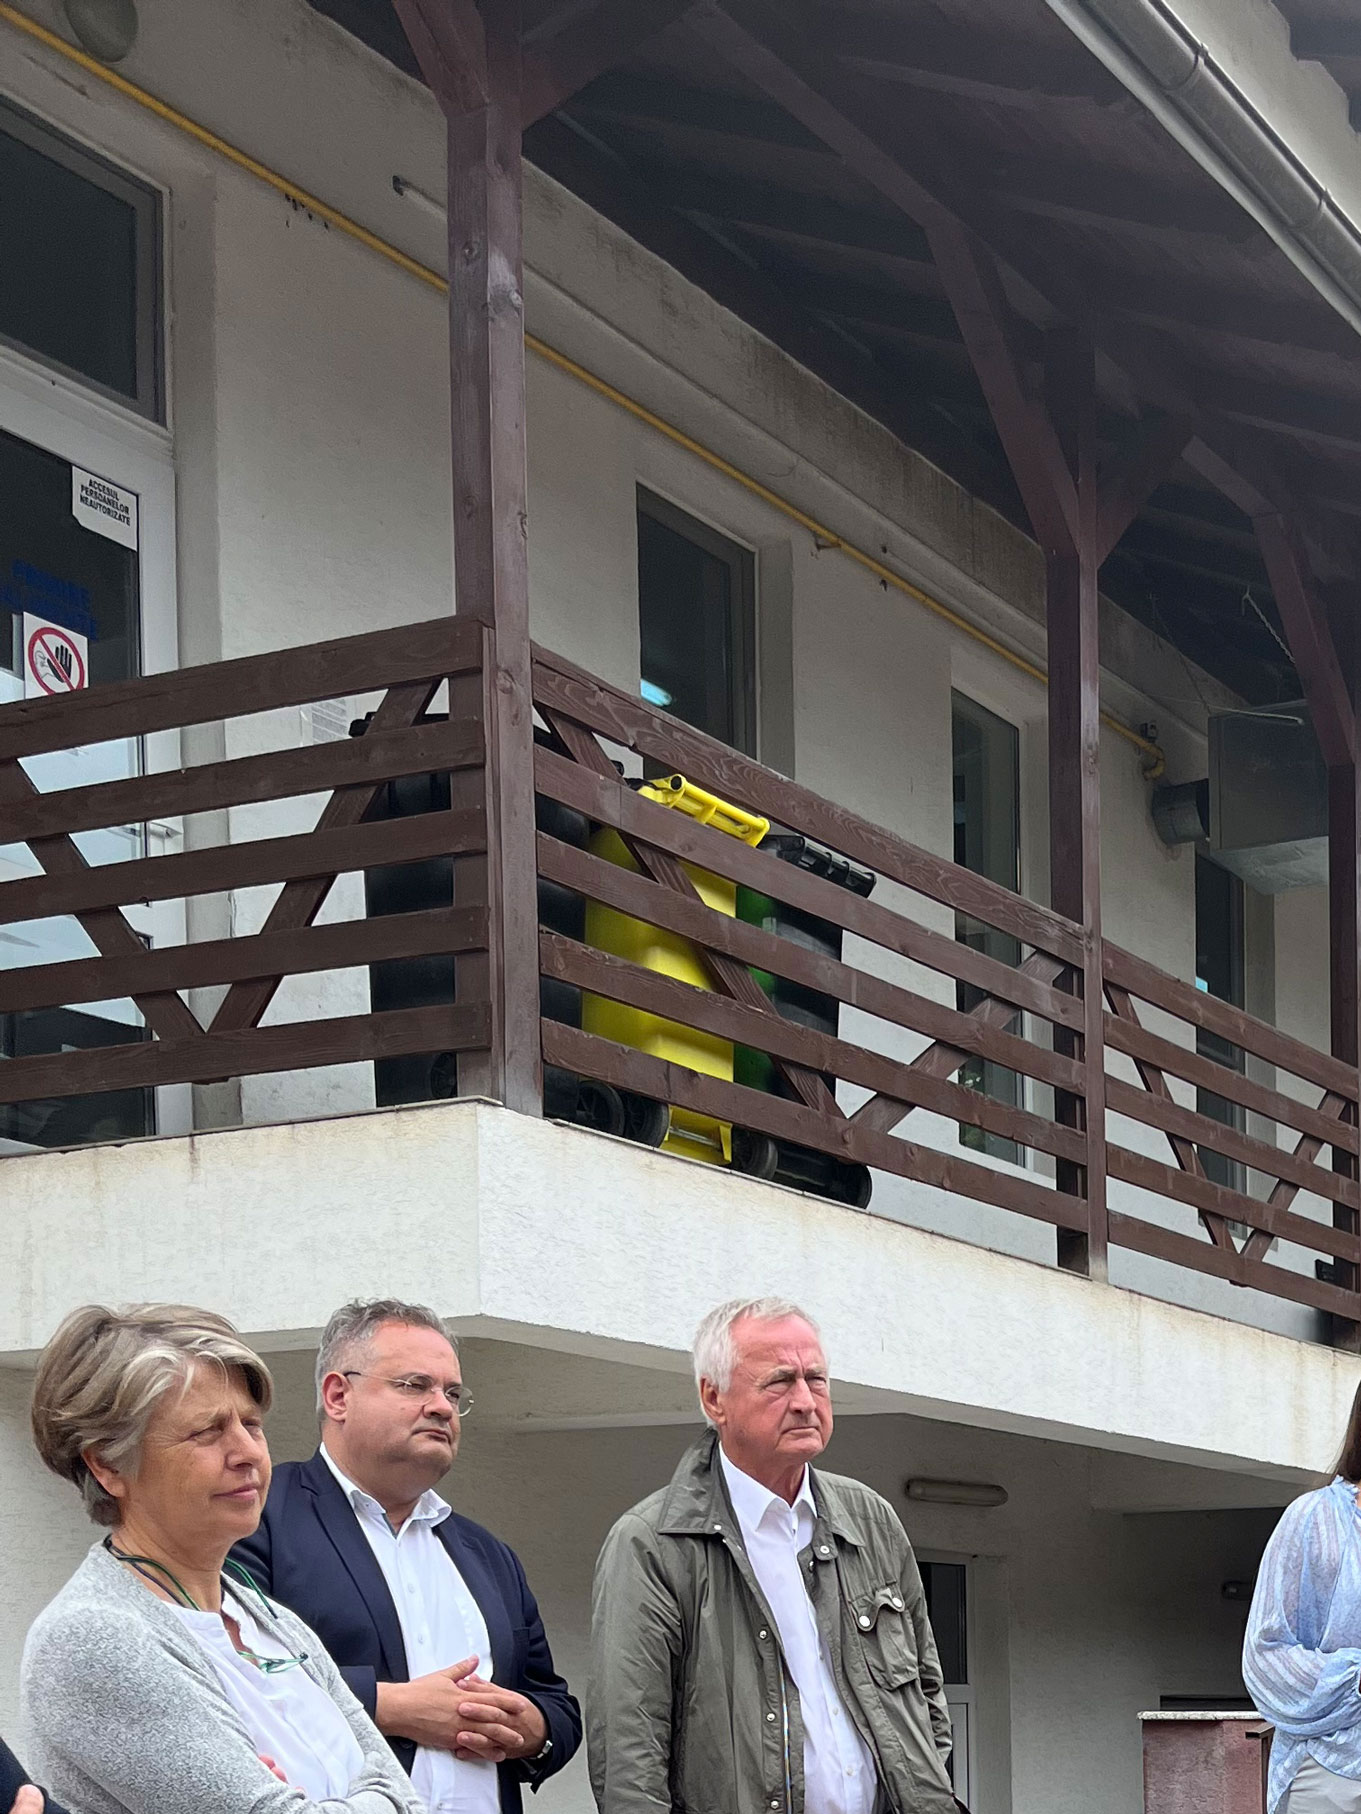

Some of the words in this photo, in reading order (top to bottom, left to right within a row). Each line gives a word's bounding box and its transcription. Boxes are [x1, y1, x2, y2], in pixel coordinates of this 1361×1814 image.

[81, 485, 129, 515] PERSOANELOR
[89, 479, 119, 501] ACCESUL
[80, 494, 130, 526] NEAUTORIZATE
